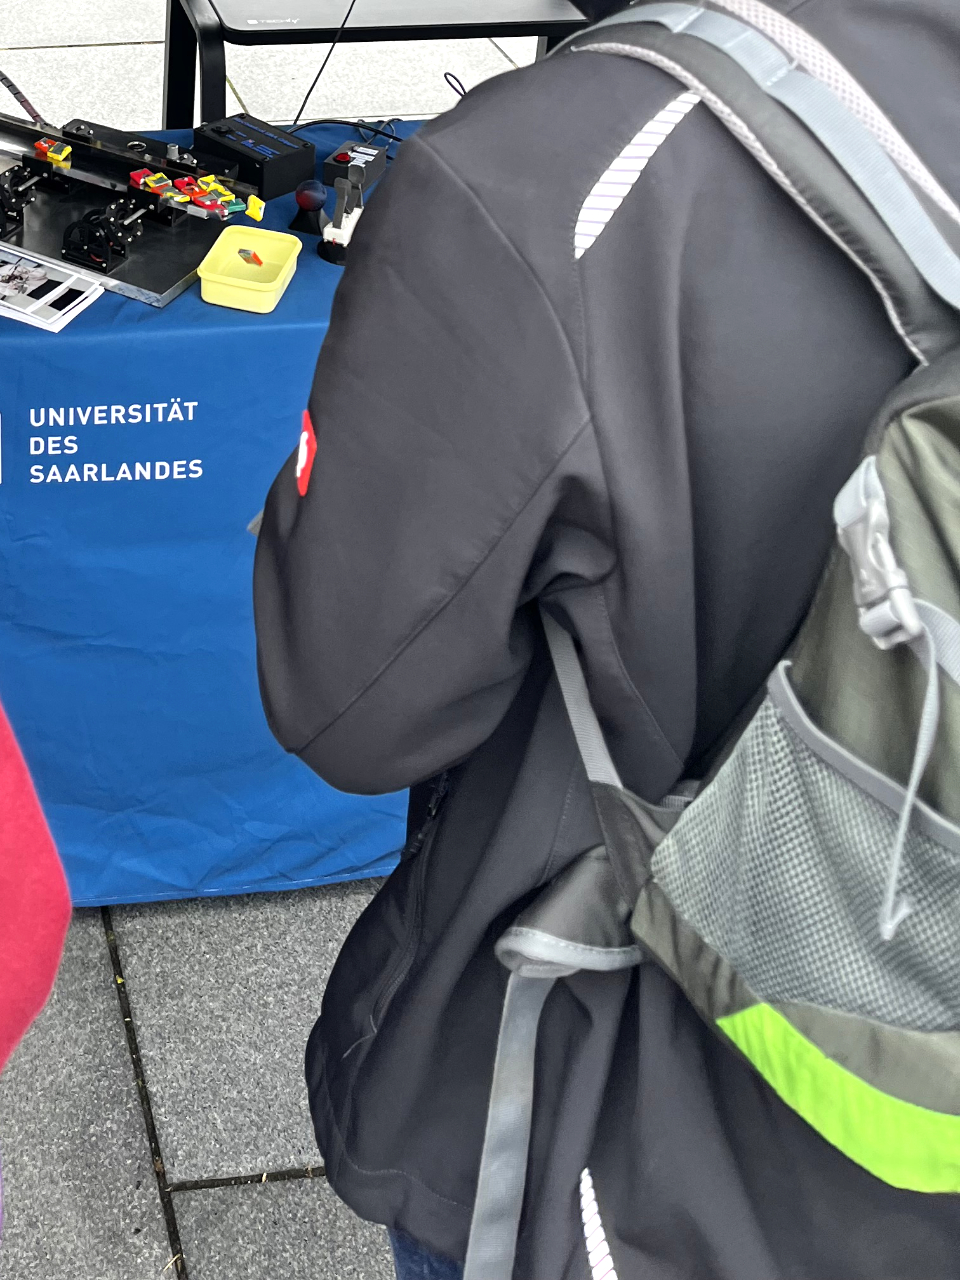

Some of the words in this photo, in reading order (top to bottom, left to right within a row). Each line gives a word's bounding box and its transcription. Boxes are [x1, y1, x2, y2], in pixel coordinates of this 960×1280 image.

[29, 397, 199, 427] UNIVERSITÄT
[29, 435, 79, 455] DES
[29, 459, 204, 484] SAARLANDES
